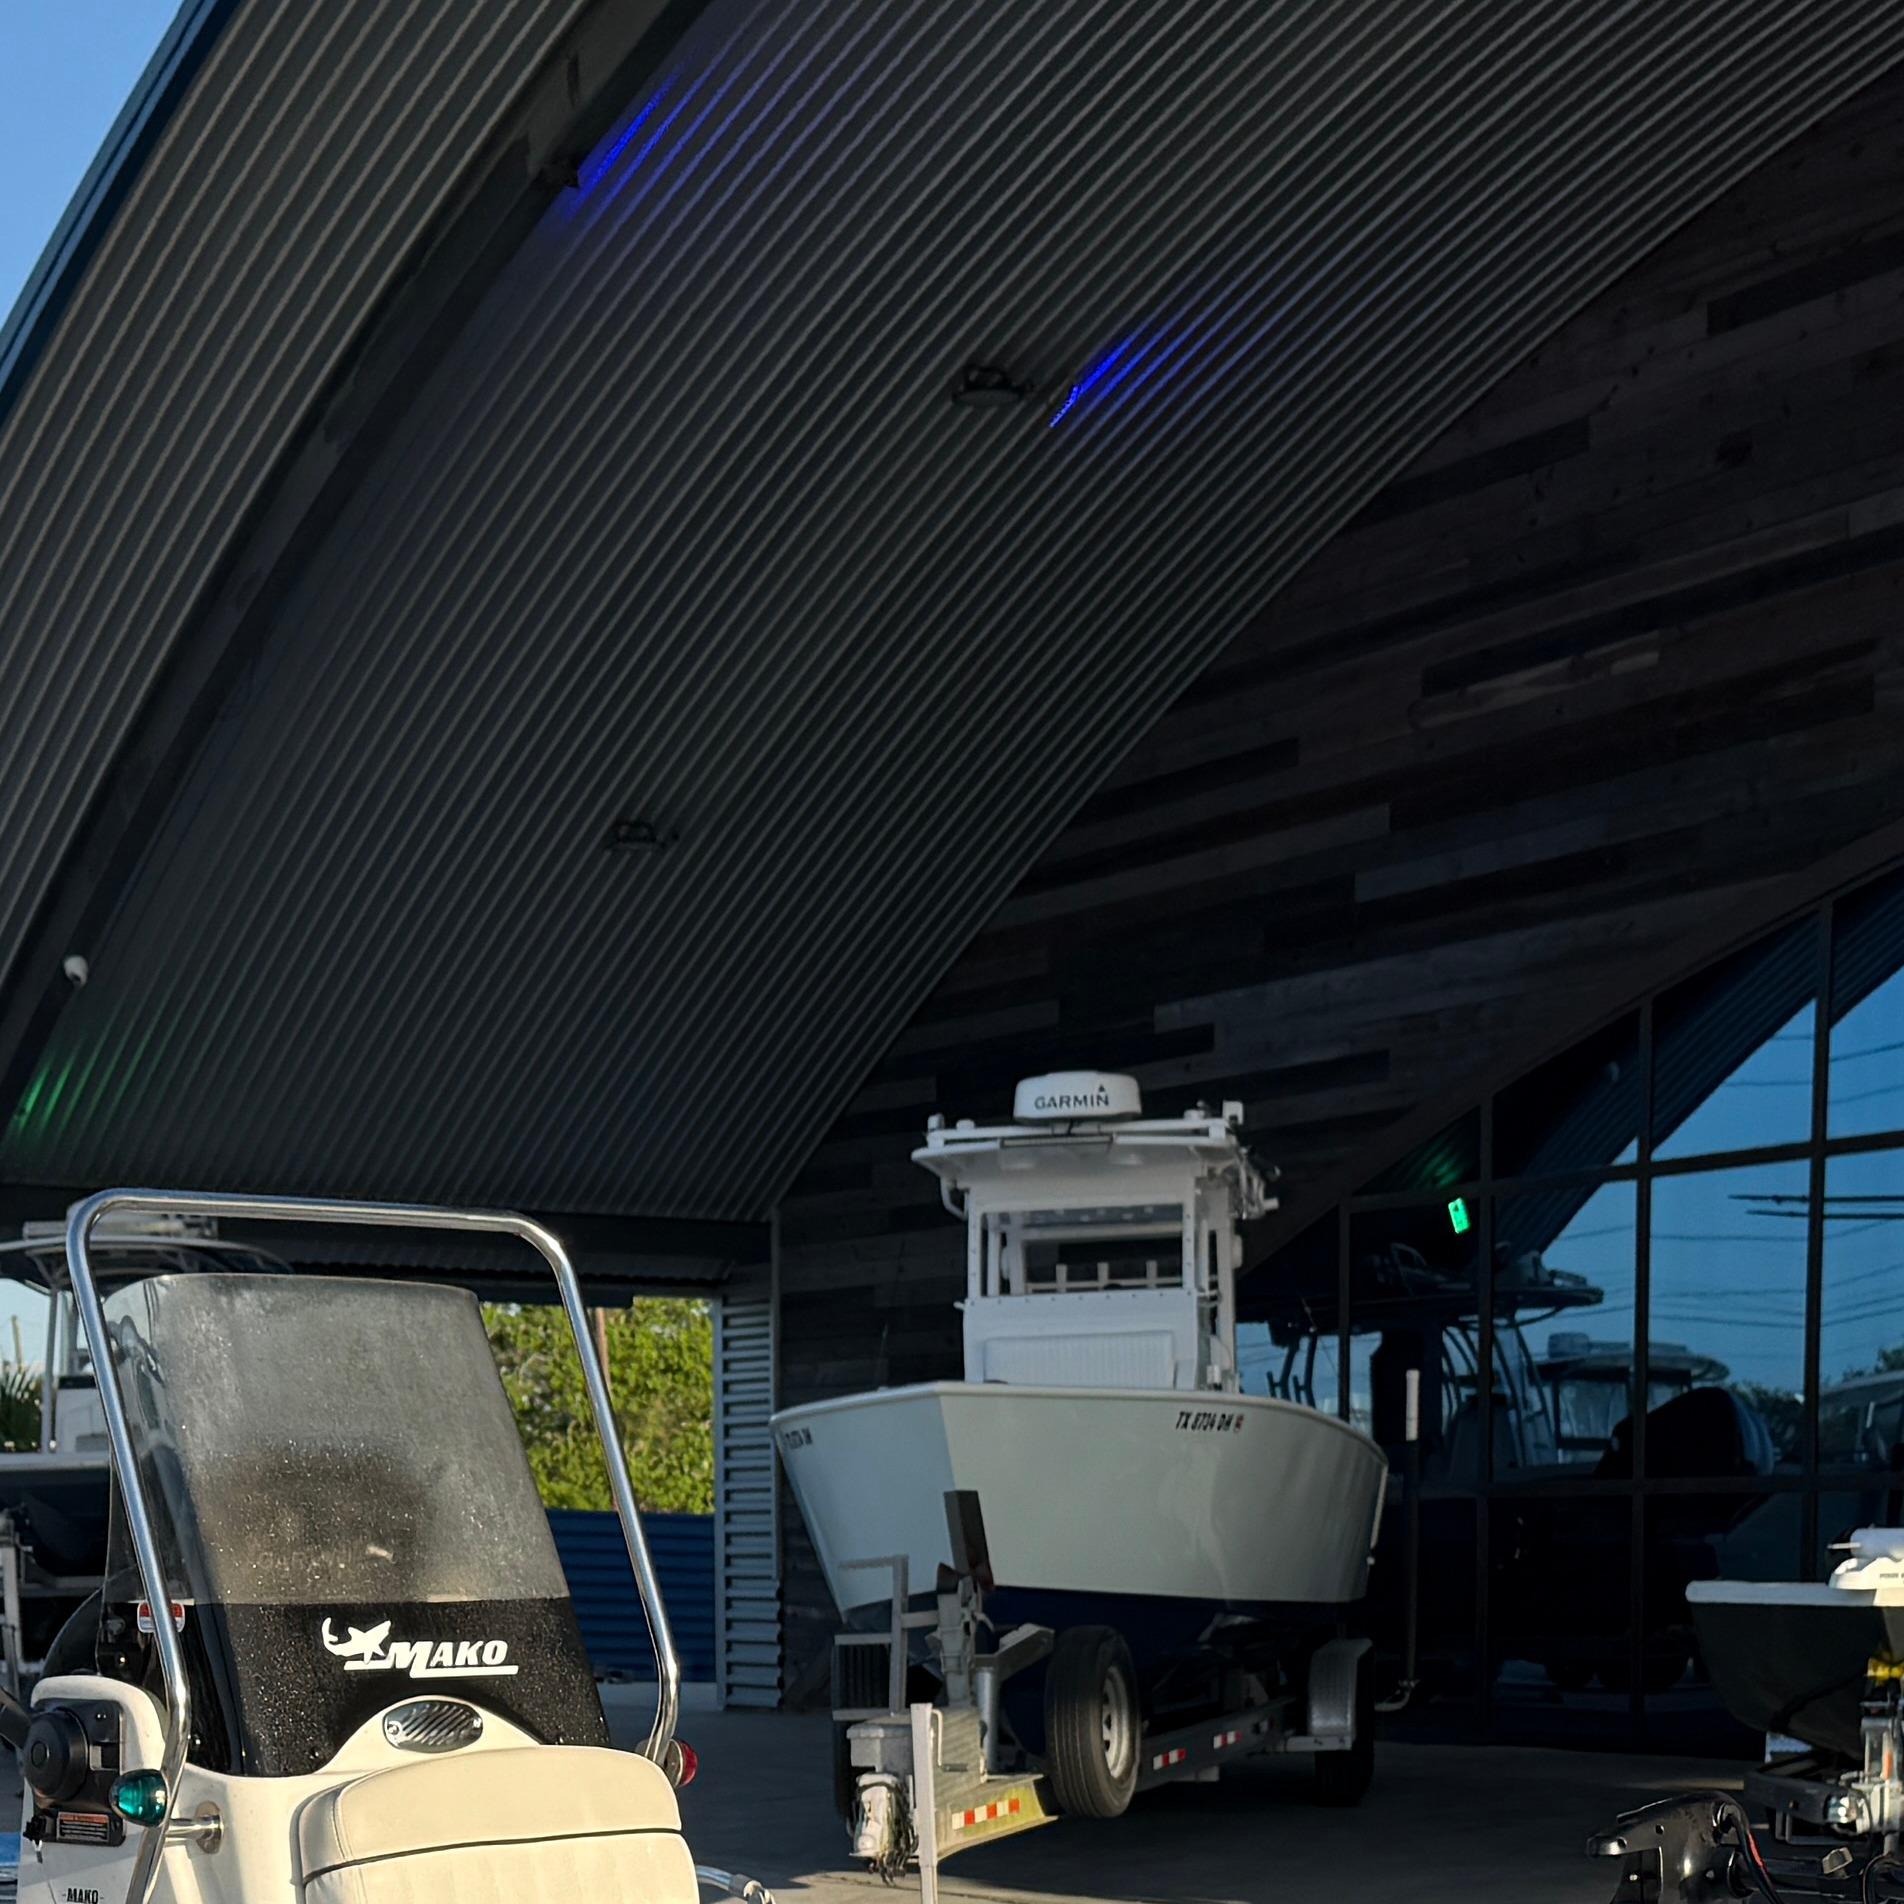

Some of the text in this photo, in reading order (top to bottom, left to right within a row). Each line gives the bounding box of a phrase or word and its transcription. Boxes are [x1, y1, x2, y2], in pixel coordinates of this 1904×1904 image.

[1034, 1093, 1110, 1110] GARMIN
[343, 1640, 519, 1678] MAKO
[66, 1887, 99, 1904] MAKO
